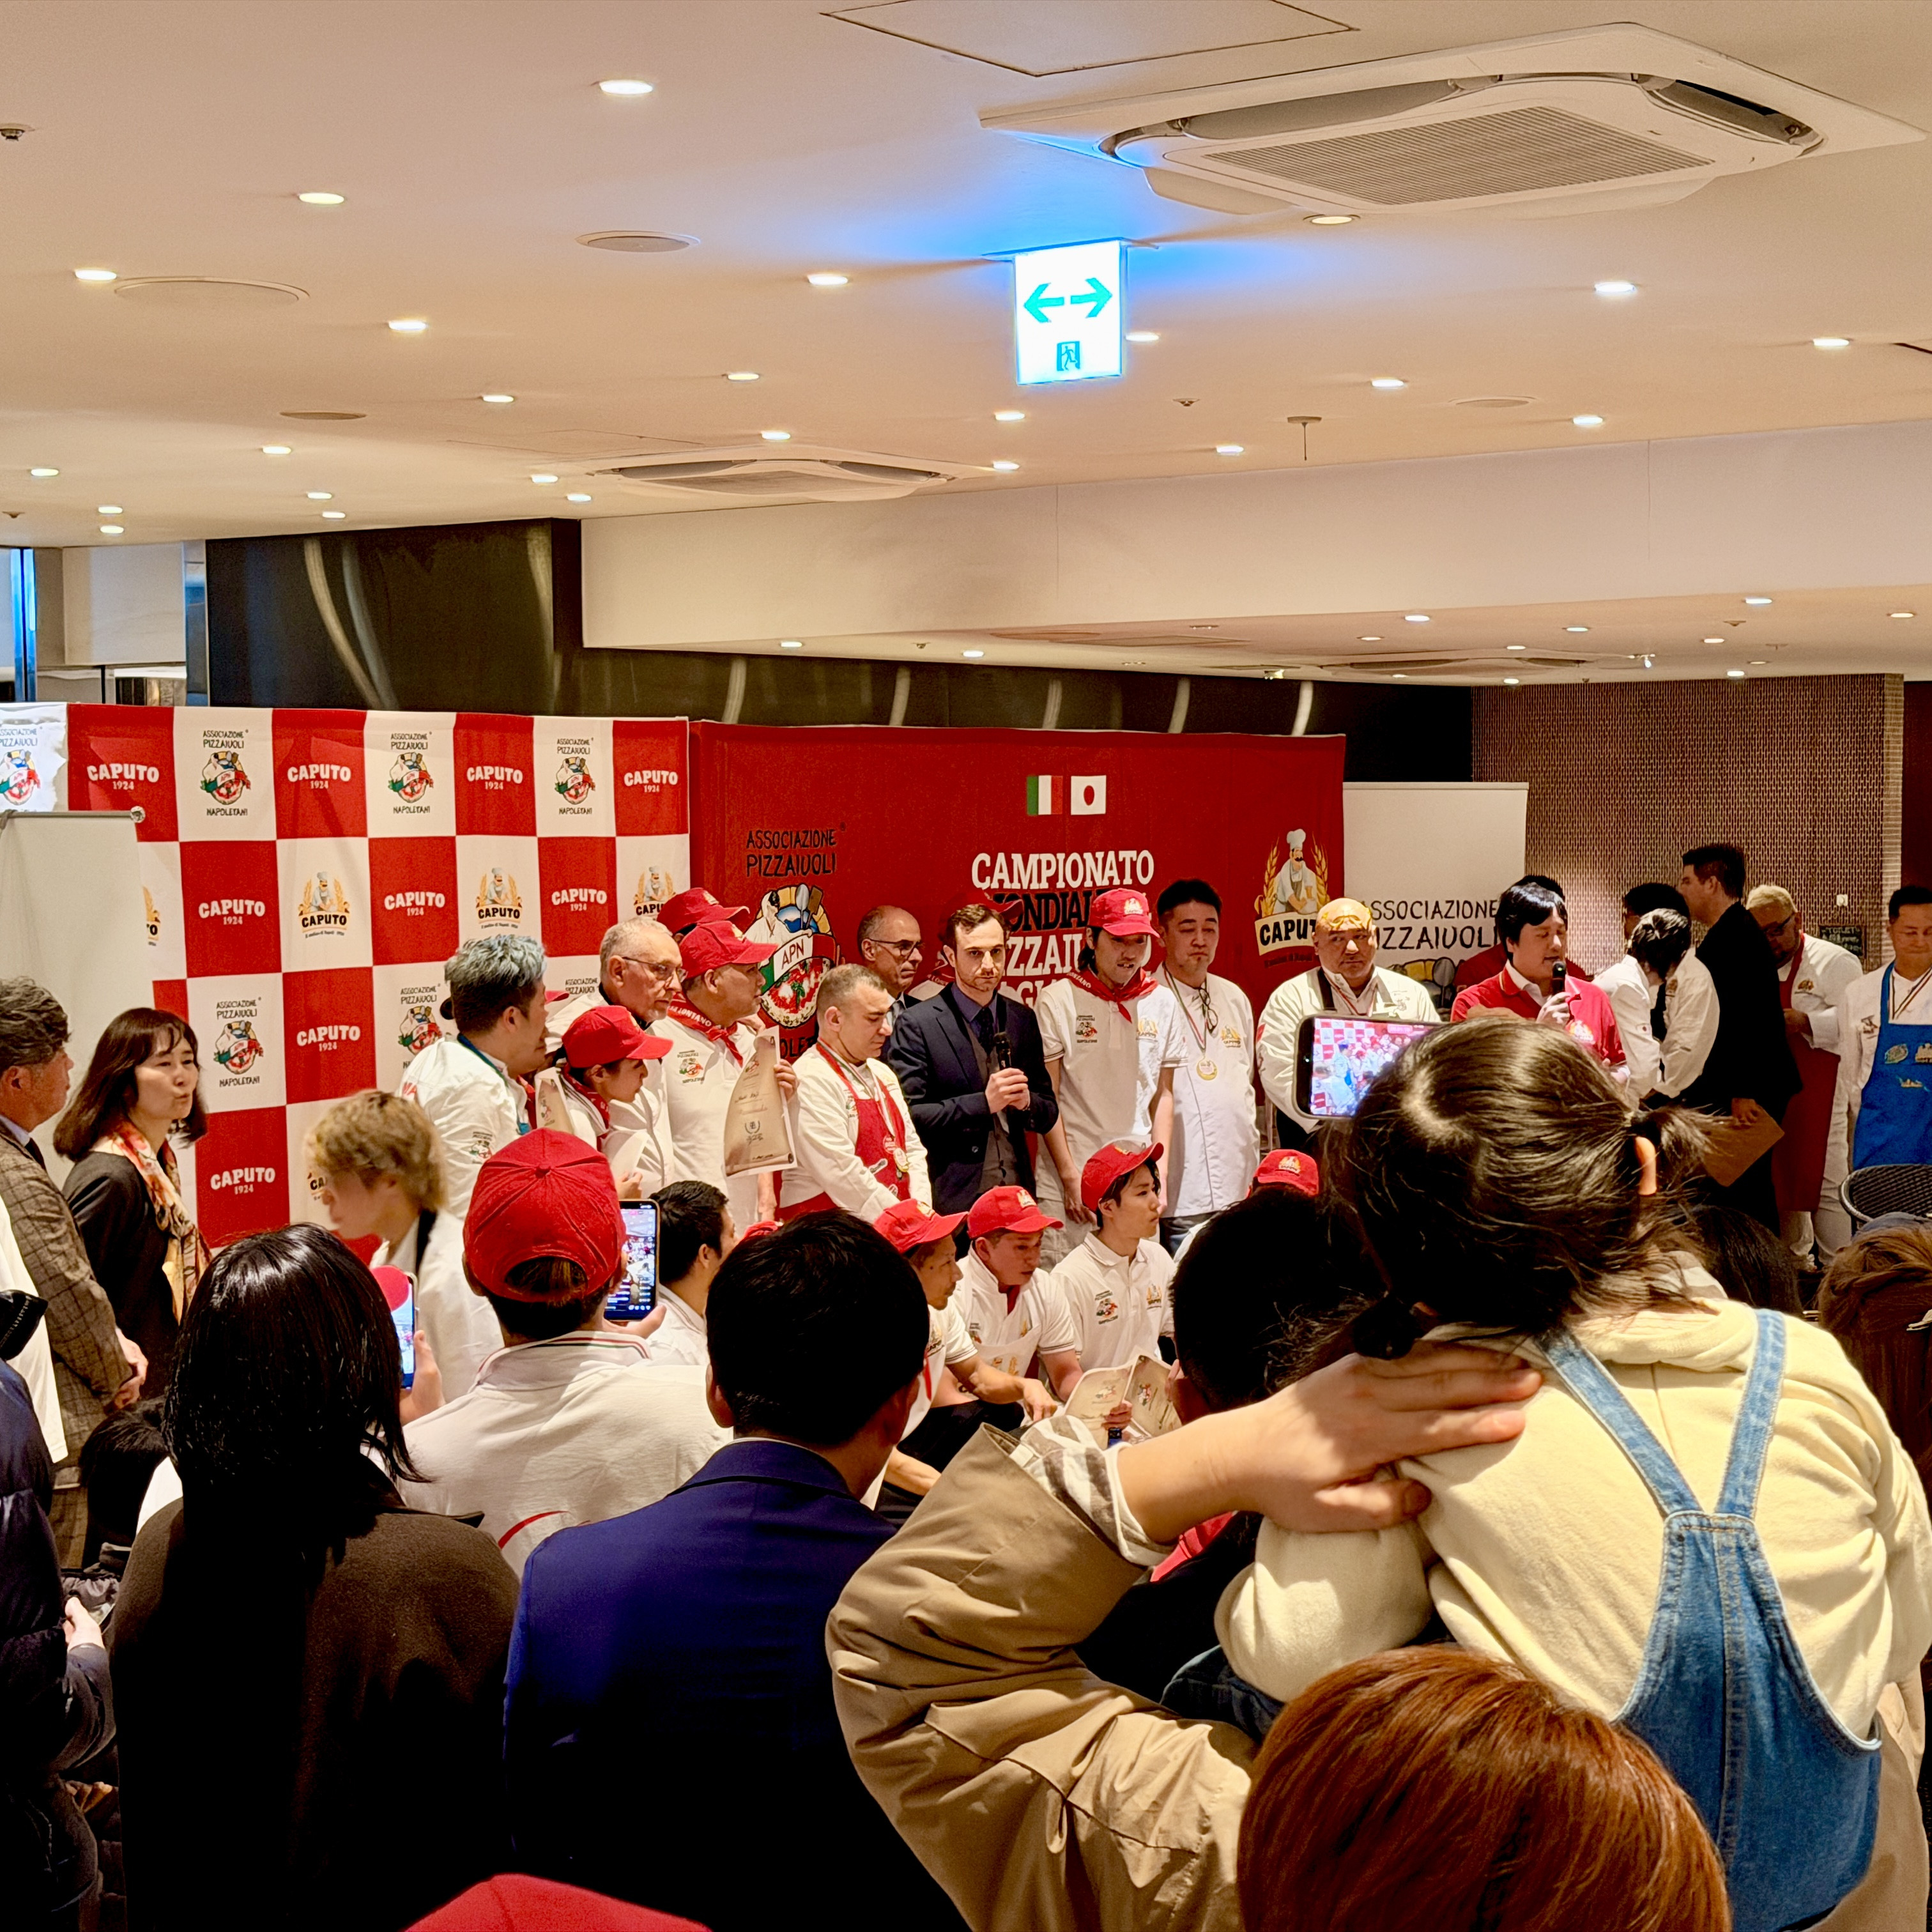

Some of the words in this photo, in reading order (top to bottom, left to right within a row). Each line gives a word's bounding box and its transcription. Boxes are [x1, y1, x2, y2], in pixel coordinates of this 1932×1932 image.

[203, 730, 244, 739] ASSOCIAZIONE
[203, 739, 245, 749] PIZZAIUOLI
[86, 763, 160, 783] CAPUTO
[287, 763, 351, 782] CAPUTO
[466, 765, 523, 785] CAPUTO
[624, 770, 678, 786] CAPUTO
[112, 781, 135, 790] 1924
[310, 781, 329, 789] 1924
[485, 781, 503, 790] 1924
[643, 785, 660, 793] 1924
[206, 808, 248, 816] NAPOLETANI
[393, 806, 431, 814] NAPOLETANI
[746, 829, 836, 849] ASSOCIAZIONE
[746, 853, 836, 878] PIZZAIUOLI
[971, 850, 1154, 889] CAMPIONATO
[384, 891, 445, 910] CAPUTO
[551, 888, 608, 905] CAPUTO
[198, 899, 266, 919] CAPUTO
[406, 907, 424, 916] 1924
[478, 907, 520, 919] CAPUTO
[570, 903, 587, 912] 1924
[636, 903, 664, 916] CAPU
[1370, 900, 1498, 921] SSOCIAZIONE
[223, 916, 243, 925] 1924
[302, 914, 347, 928] CAPUTO
[1376, 926, 1498, 949] IZZAIUOLI
[781, 939, 804, 969] APN
[296, 1025, 361, 1047] CAPUTO
[318, 1041, 337, 1052] 1924
[210, 1167, 276, 1190] CAPUTO
[234, 1184, 254, 1195] 1924
